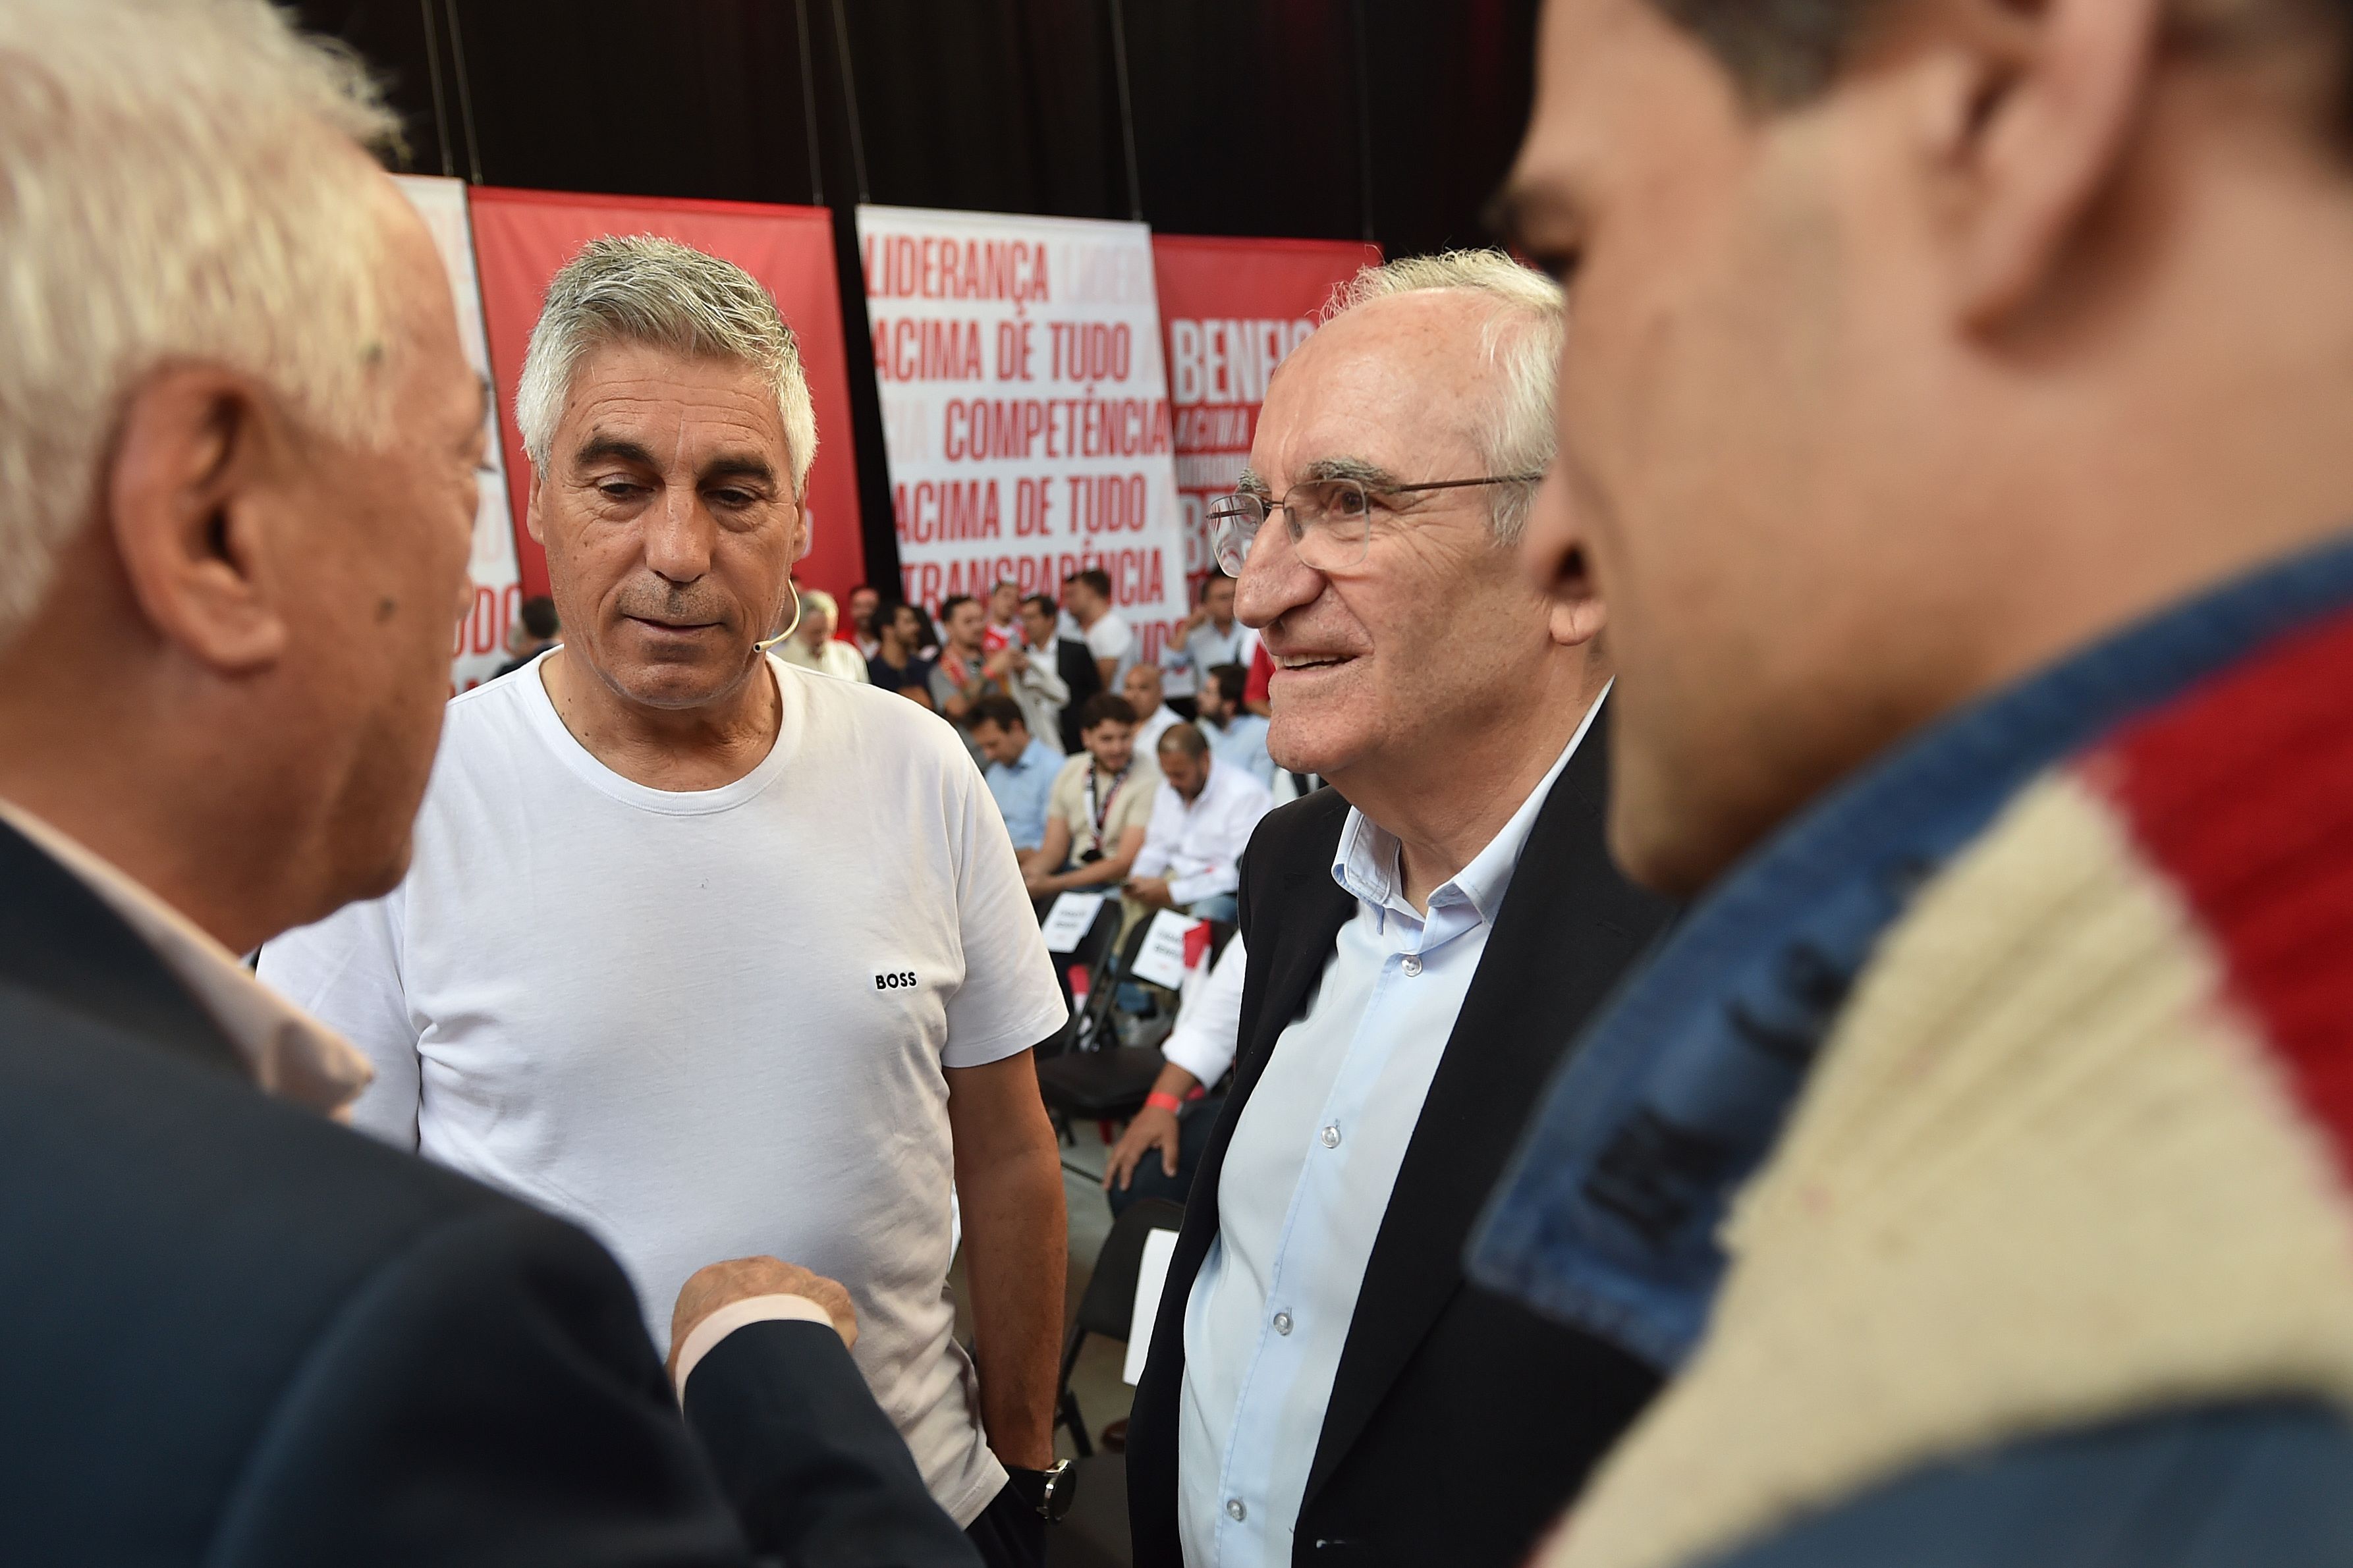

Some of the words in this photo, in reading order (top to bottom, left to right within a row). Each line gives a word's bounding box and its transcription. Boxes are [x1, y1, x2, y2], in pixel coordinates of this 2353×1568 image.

[864, 234, 1049, 315] LIDERANÇA
[873, 317, 983, 382] ACIMA
[997, 320, 1032, 381] DE
[1048, 323, 1132, 382] TUDO
[1172, 319, 1316, 403] BENFI
[944, 385, 1170, 462] COMPETÊNCIA
[893, 476, 1001, 543] ACIMA
[1015, 475, 1054, 537] DE
[1066, 472, 1148, 533] TUDO
[900, 539, 1165, 621] TRANPANCIA
[875, 971, 917, 990] BOSS
